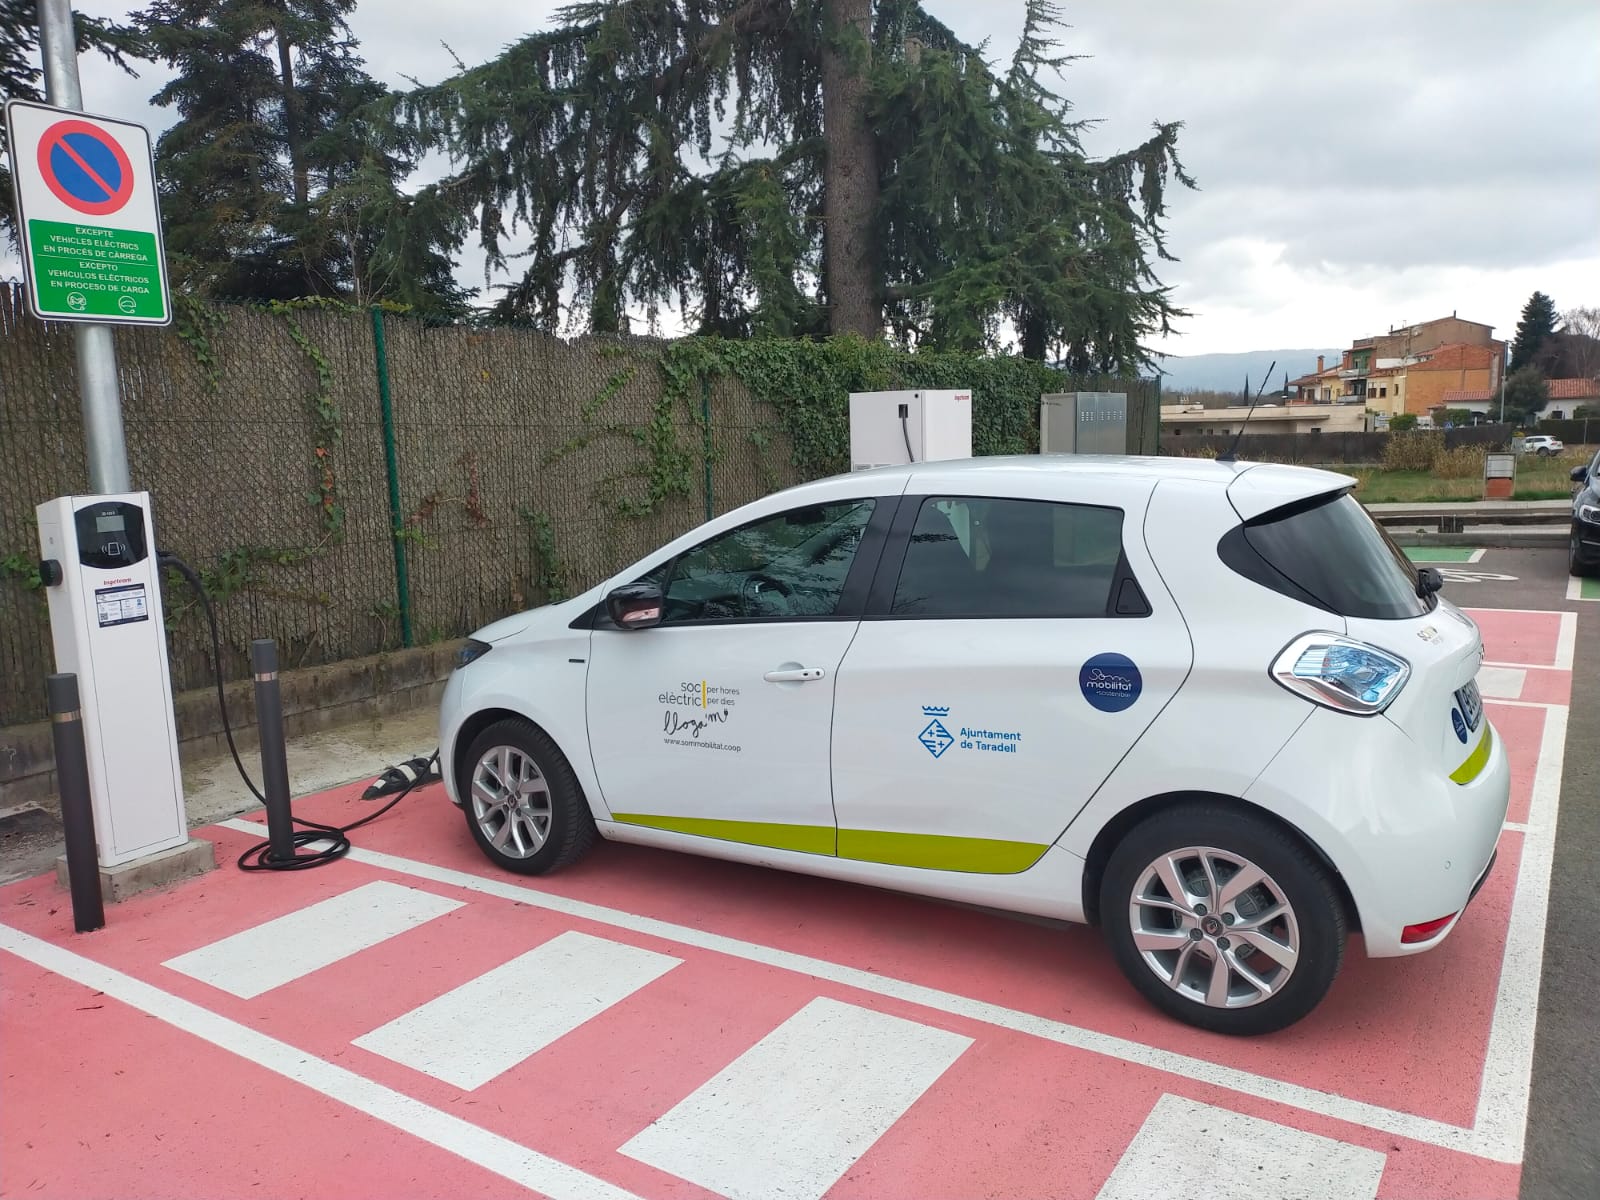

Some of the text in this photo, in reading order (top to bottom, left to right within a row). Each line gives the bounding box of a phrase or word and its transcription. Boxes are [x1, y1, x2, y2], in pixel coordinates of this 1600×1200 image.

[75, 227, 114, 238] EXCEPTE
[43, 245, 56, 253] EN
[79, 261, 118, 271] EXCEPTO
[50, 280, 63, 288] EN
[65, 281, 106, 291] PROCESO
[121, 285, 150, 294] CARGA
[706, 686, 740, 695] per hores
[1086, 681, 1132, 690] mobilitat
[658, 691, 702, 707] elèctric
[707, 697, 719, 705] per
[960, 727, 1022, 741] Ajuntament
[960, 740, 1016, 753] de Taradell
